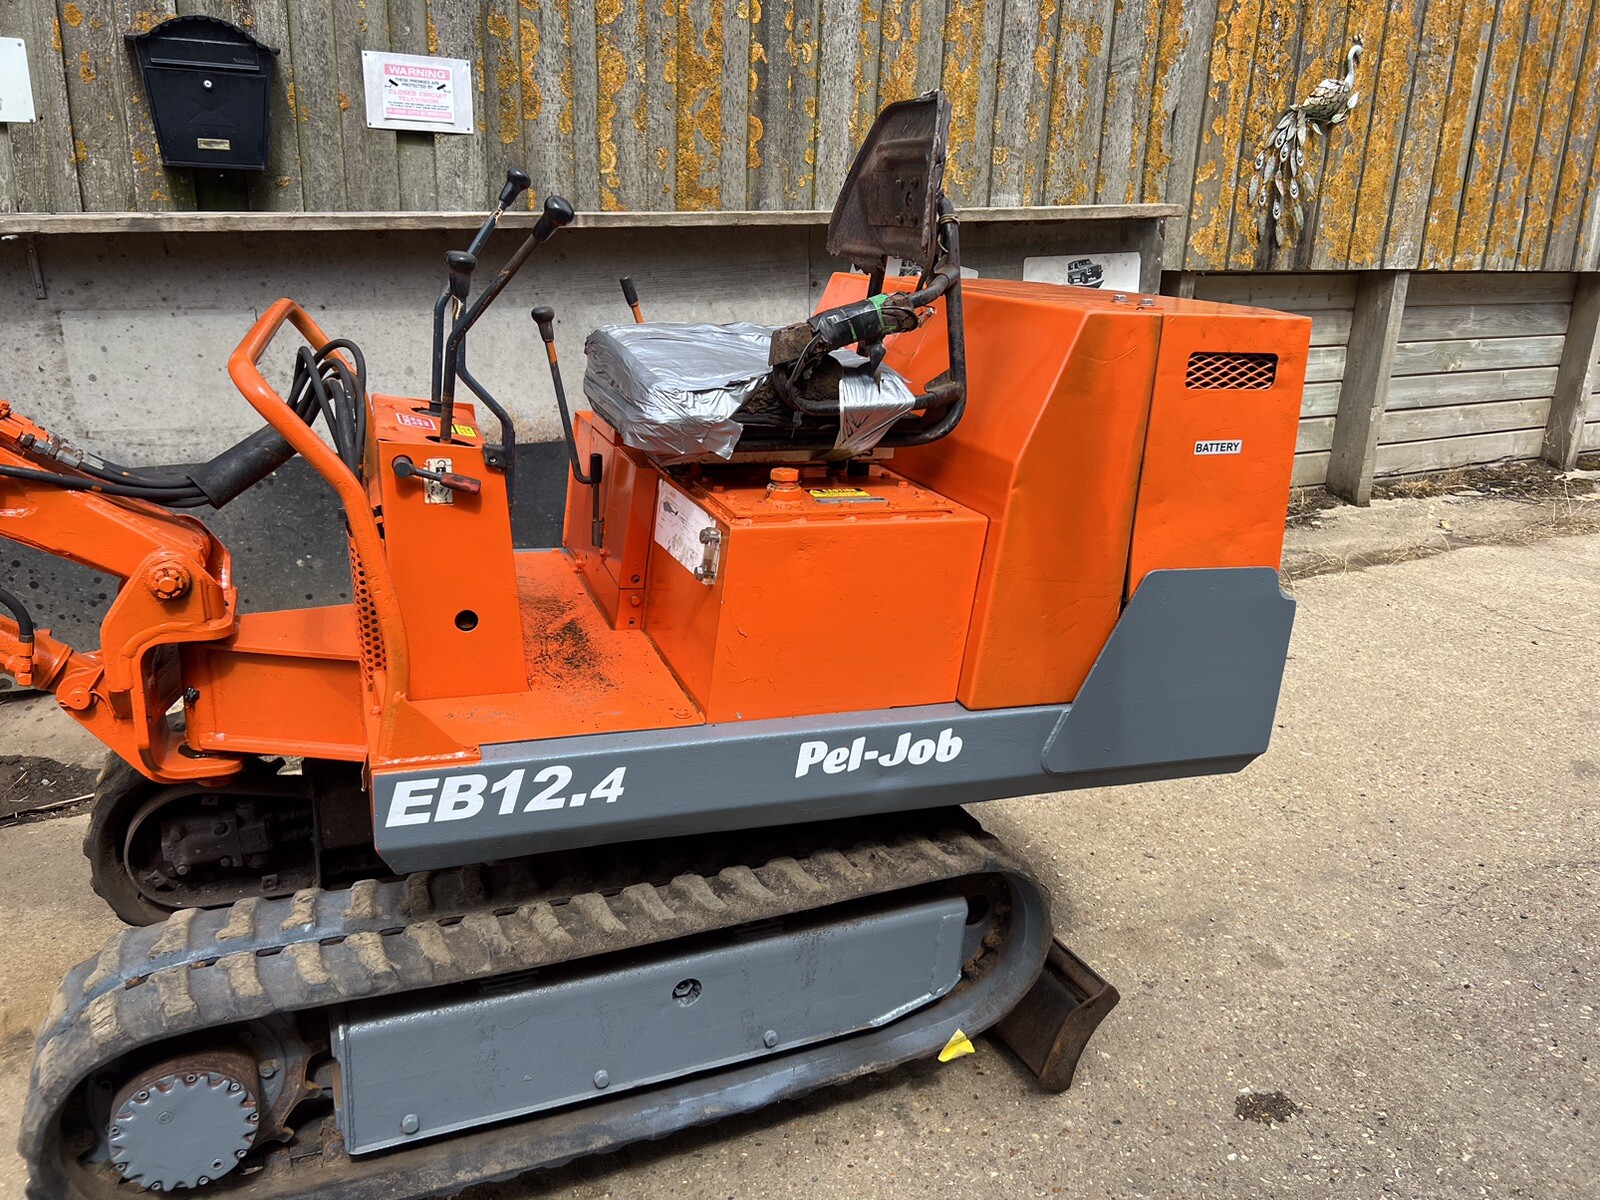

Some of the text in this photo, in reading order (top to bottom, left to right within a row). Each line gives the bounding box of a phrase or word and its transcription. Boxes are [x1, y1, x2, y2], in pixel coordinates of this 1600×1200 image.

[388, 65, 446, 79] WARNING
[398, 96, 439, 104] TELEVISION
[1196, 442, 1239, 453] BATTERY
[795, 728, 963, 778] Pel-Job
[385, 765, 626, 828] EB12.4
